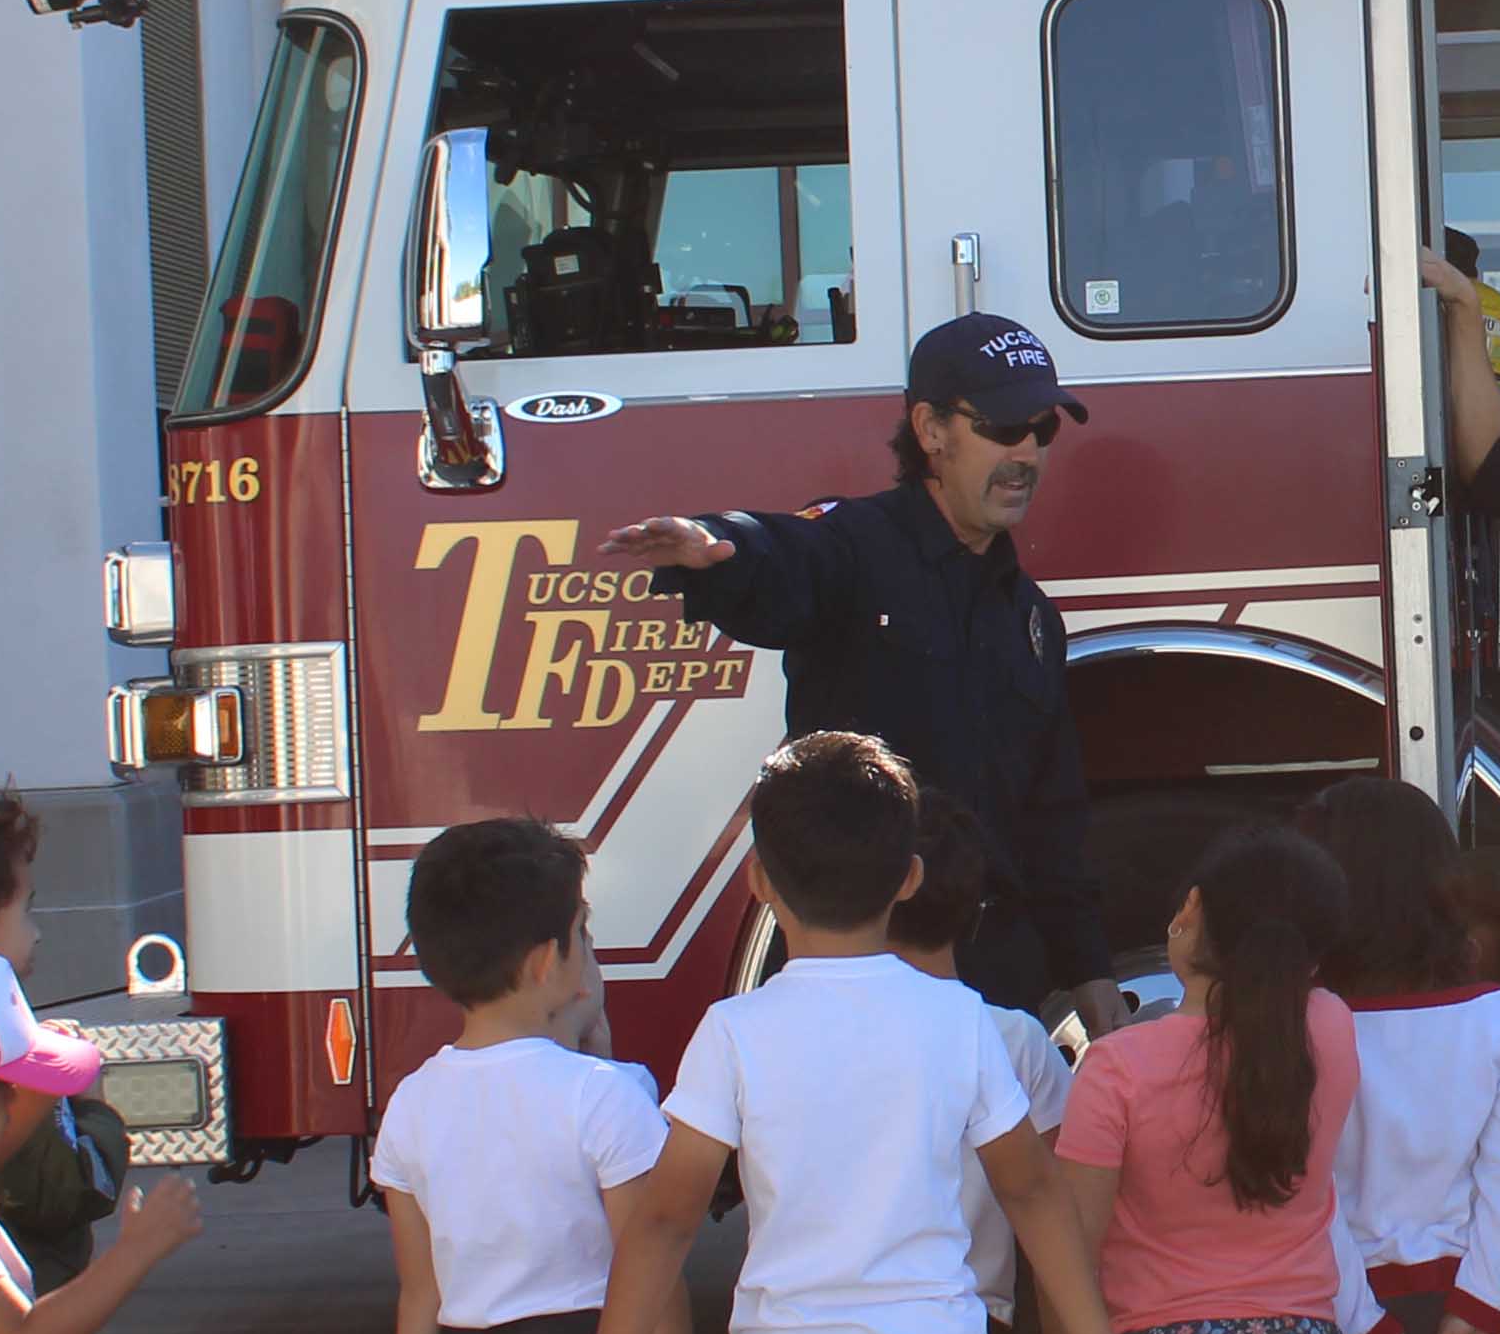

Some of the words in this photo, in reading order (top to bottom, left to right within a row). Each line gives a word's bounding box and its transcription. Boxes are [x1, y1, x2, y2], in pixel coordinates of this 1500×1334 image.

[979, 330, 1045, 358] TUCSO
[1005, 349, 1048, 367] FIRE
[534, 397, 591, 417] Dash
[168, 458, 260, 506] 8716
[500, 610, 704, 729] FIRE
[572, 653, 745, 729] DEPT
